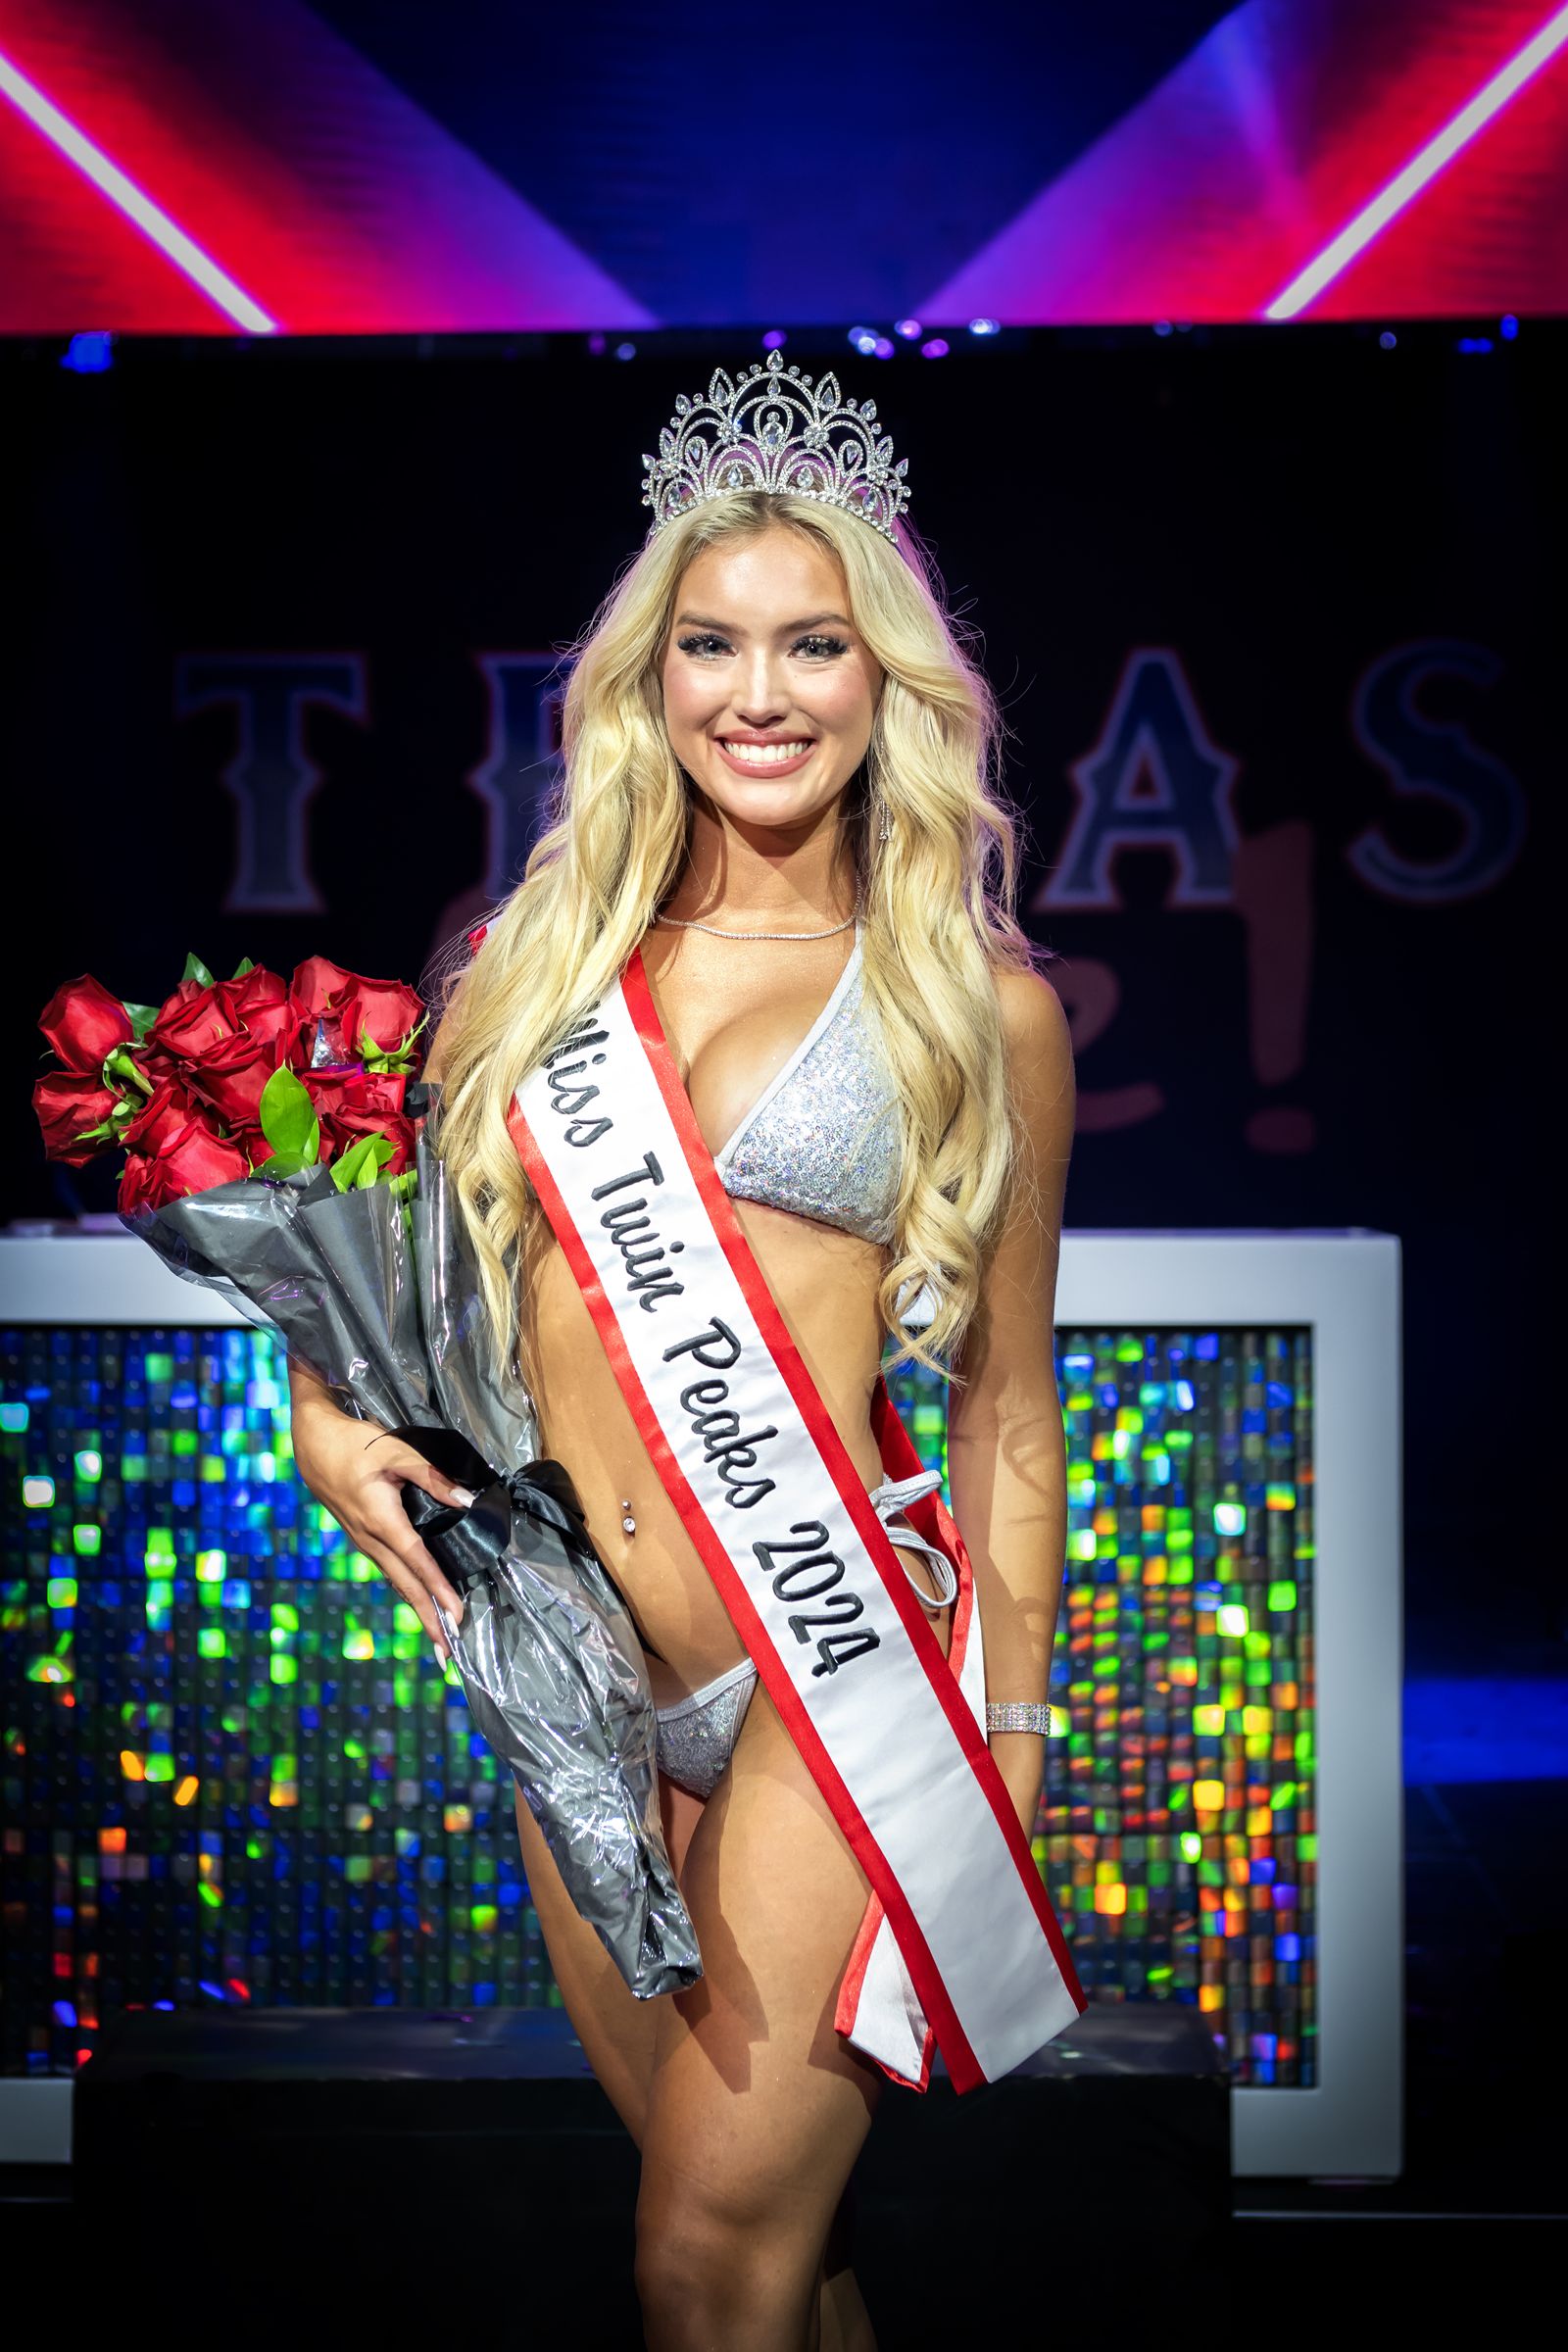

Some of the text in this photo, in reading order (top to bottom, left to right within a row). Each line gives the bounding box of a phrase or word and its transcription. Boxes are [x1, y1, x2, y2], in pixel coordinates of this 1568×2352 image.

[171, 637, 1529, 911] TAS
[592, 1151, 685, 1312] Twin
[662, 1317, 779, 1509] Peaks
[753, 1520, 881, 1679] 2024
